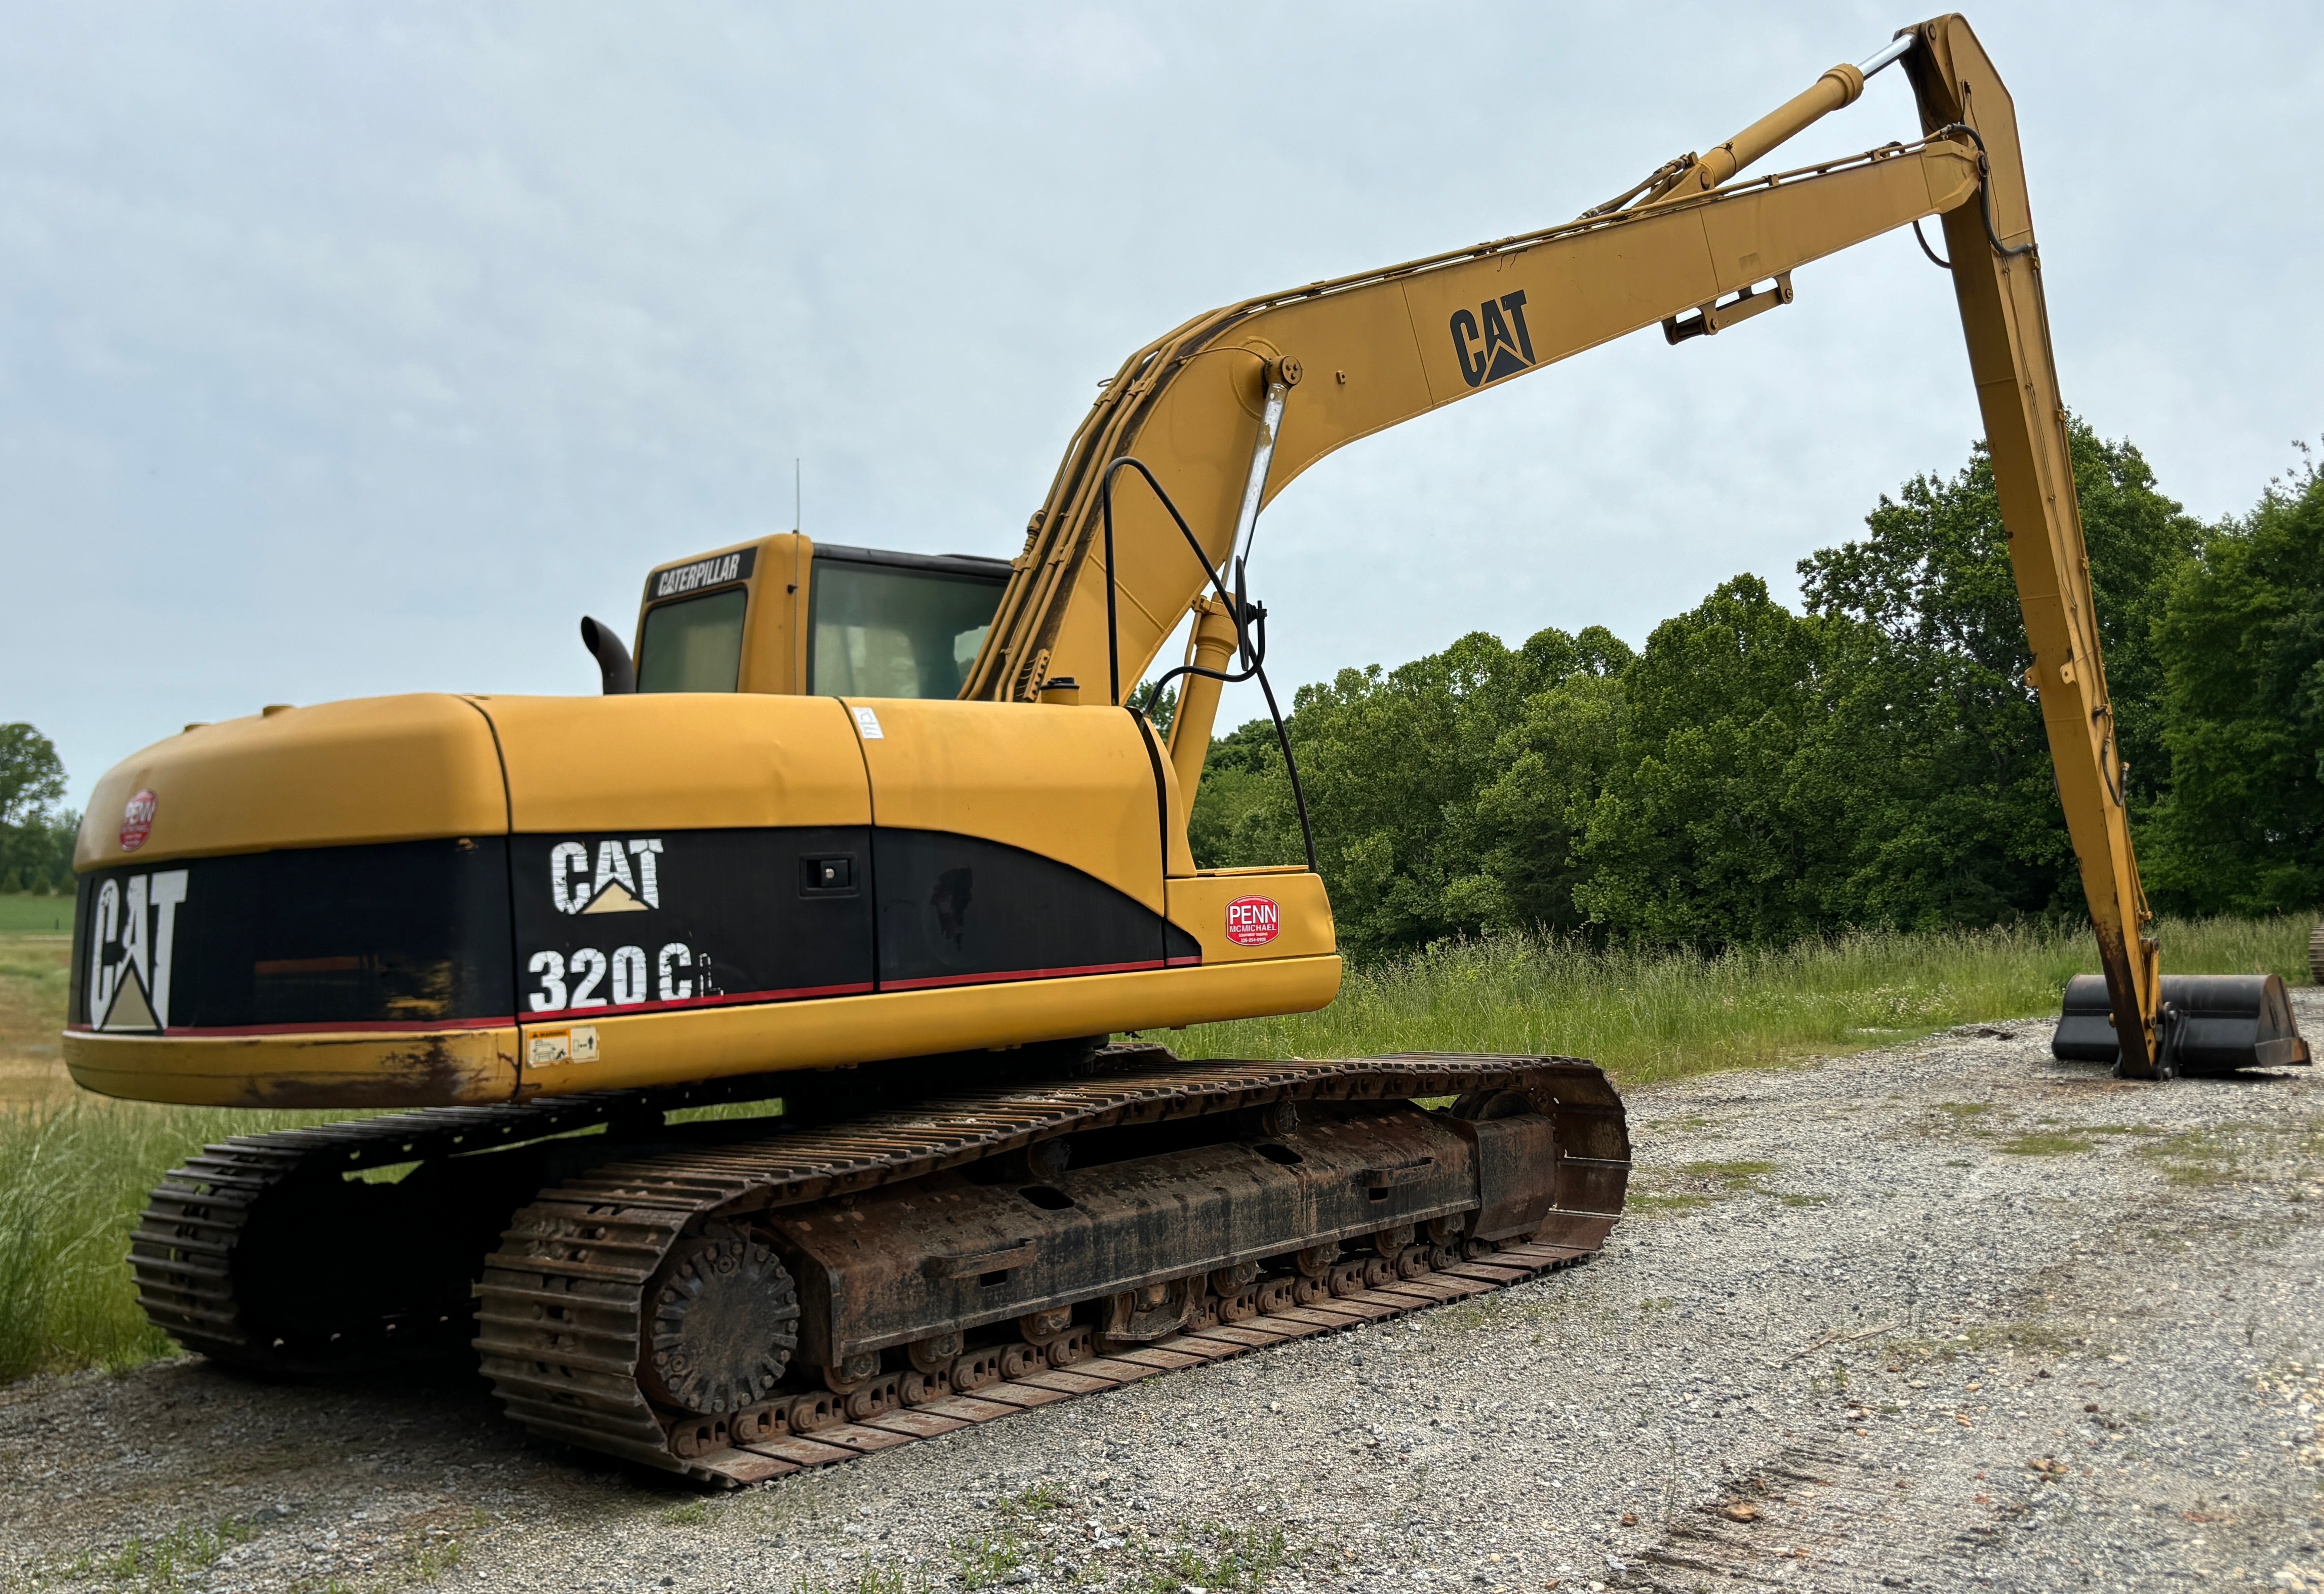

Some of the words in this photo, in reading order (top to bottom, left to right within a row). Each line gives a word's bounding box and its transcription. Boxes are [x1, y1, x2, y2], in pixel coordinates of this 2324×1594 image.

[1450, 289, 1536, 387] CAT
[658, 553, 740, 596] CATERPILLAR
[551, 839, 664, 915] CAT
[1229, 904, 1276, 925] PENN
[1229, 924, 1277, 932] MCMICHAEL
[90, 869, 189, 1031] CAT
